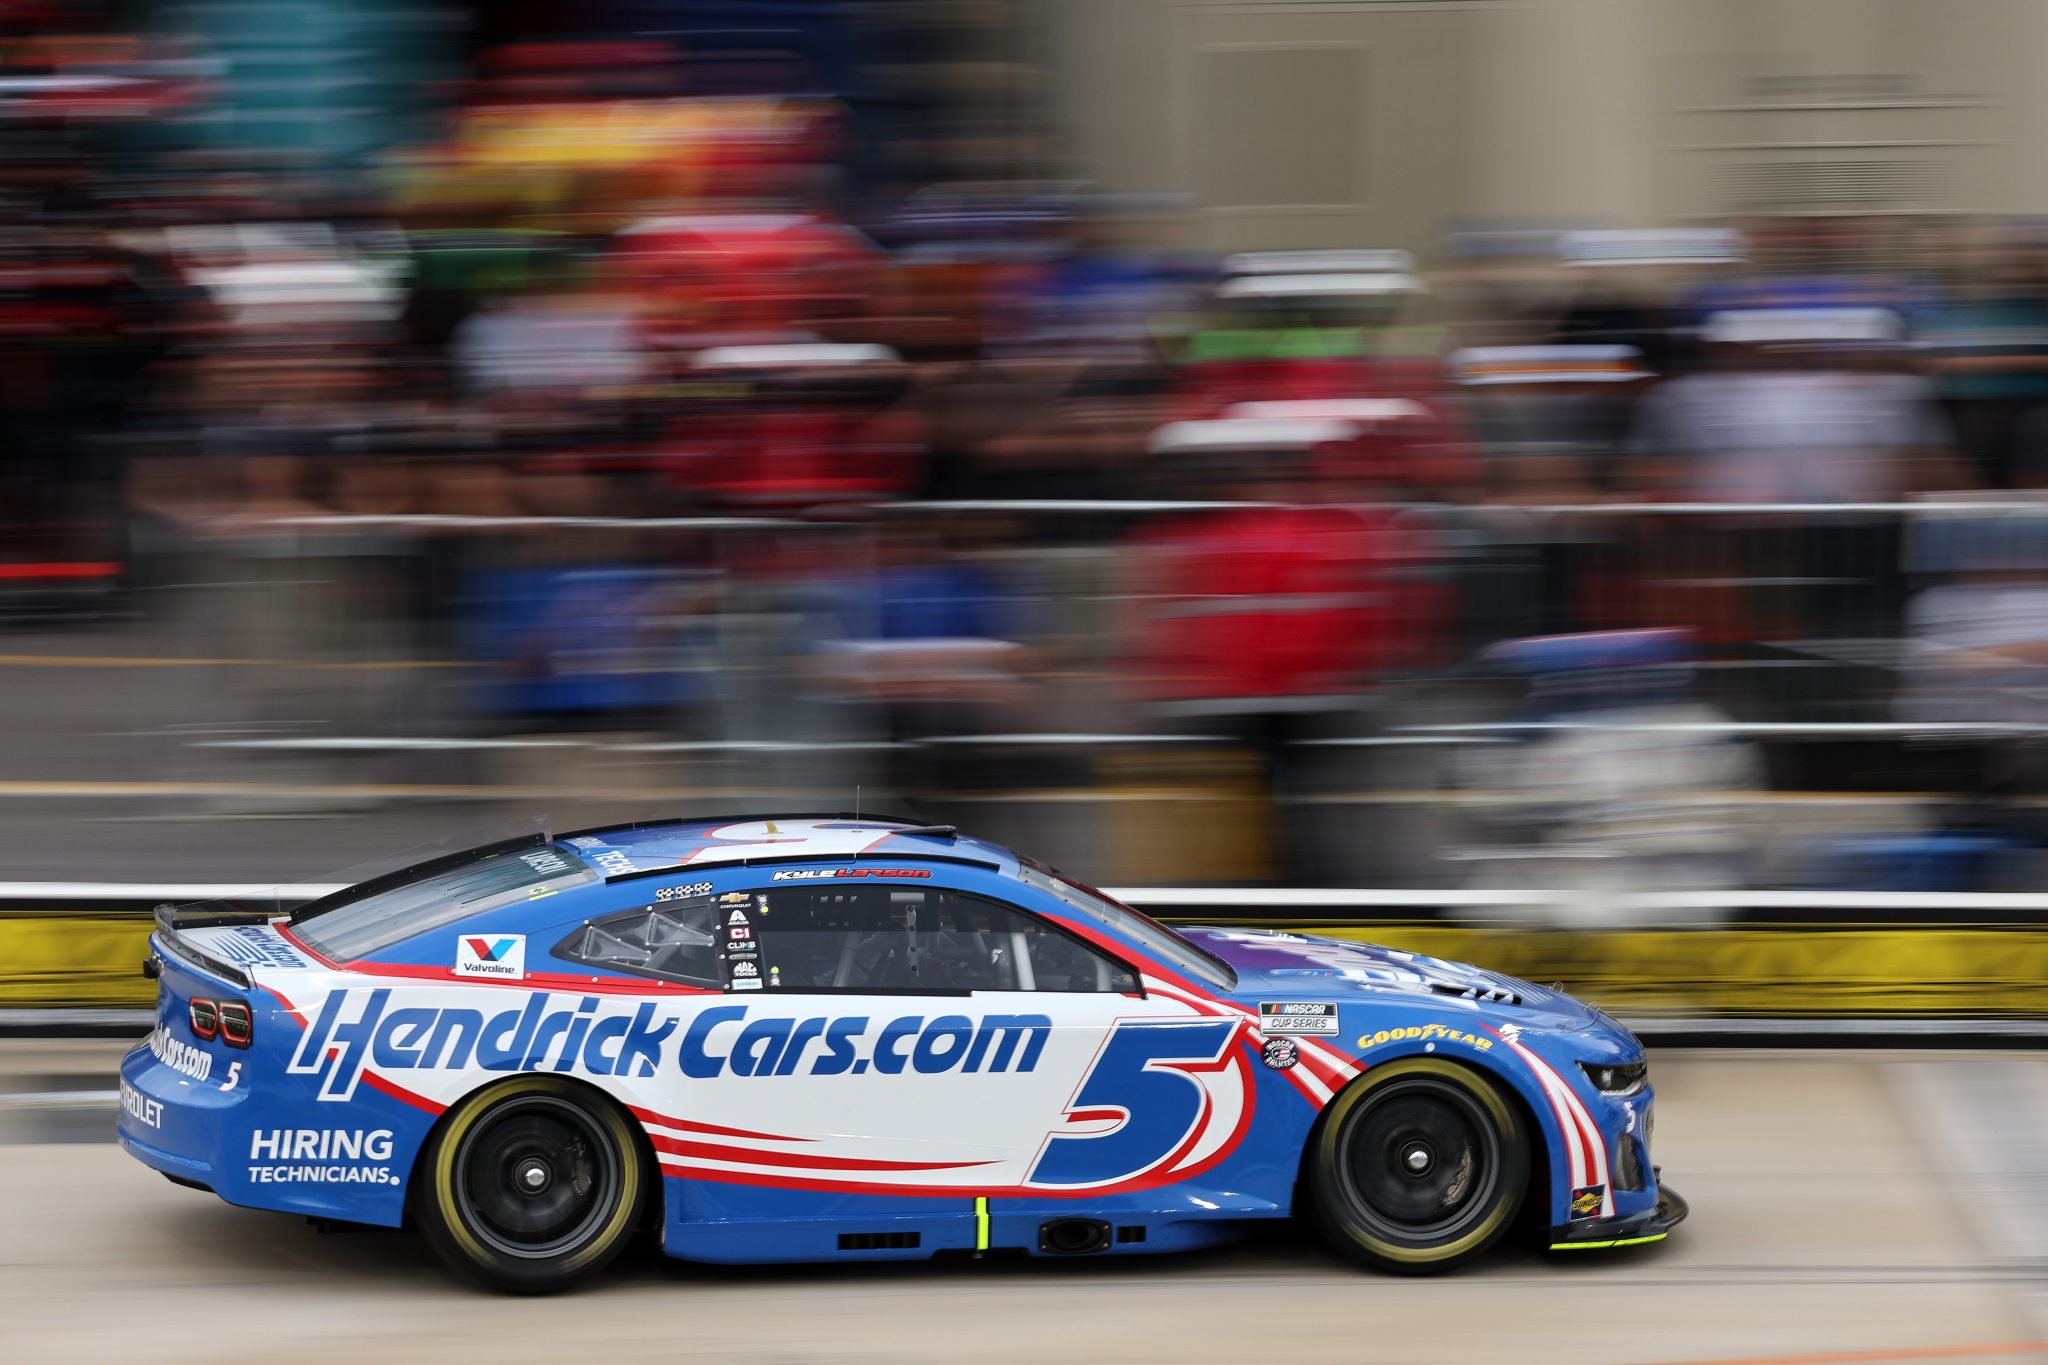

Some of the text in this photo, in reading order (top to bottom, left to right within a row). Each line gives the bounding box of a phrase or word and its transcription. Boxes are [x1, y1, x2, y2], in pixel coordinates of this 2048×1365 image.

[464, 963, 516, 974] Valvoline
[1284, 1003, 1326, 1015] NASCAR
[1272, 1018, 1328, 1029] CUP SERIES
[1265, 1040, 1295, 1052] NASCAR
[218, 1061, 242, 1092] 5
[1020, 1015, 1247, 1190] 5
[1623, 1100, 1636, 1133] 5
[249, 1129, 394, 1161] HIRING
[1573, 1194, 1604, 1210] SUNOCO
